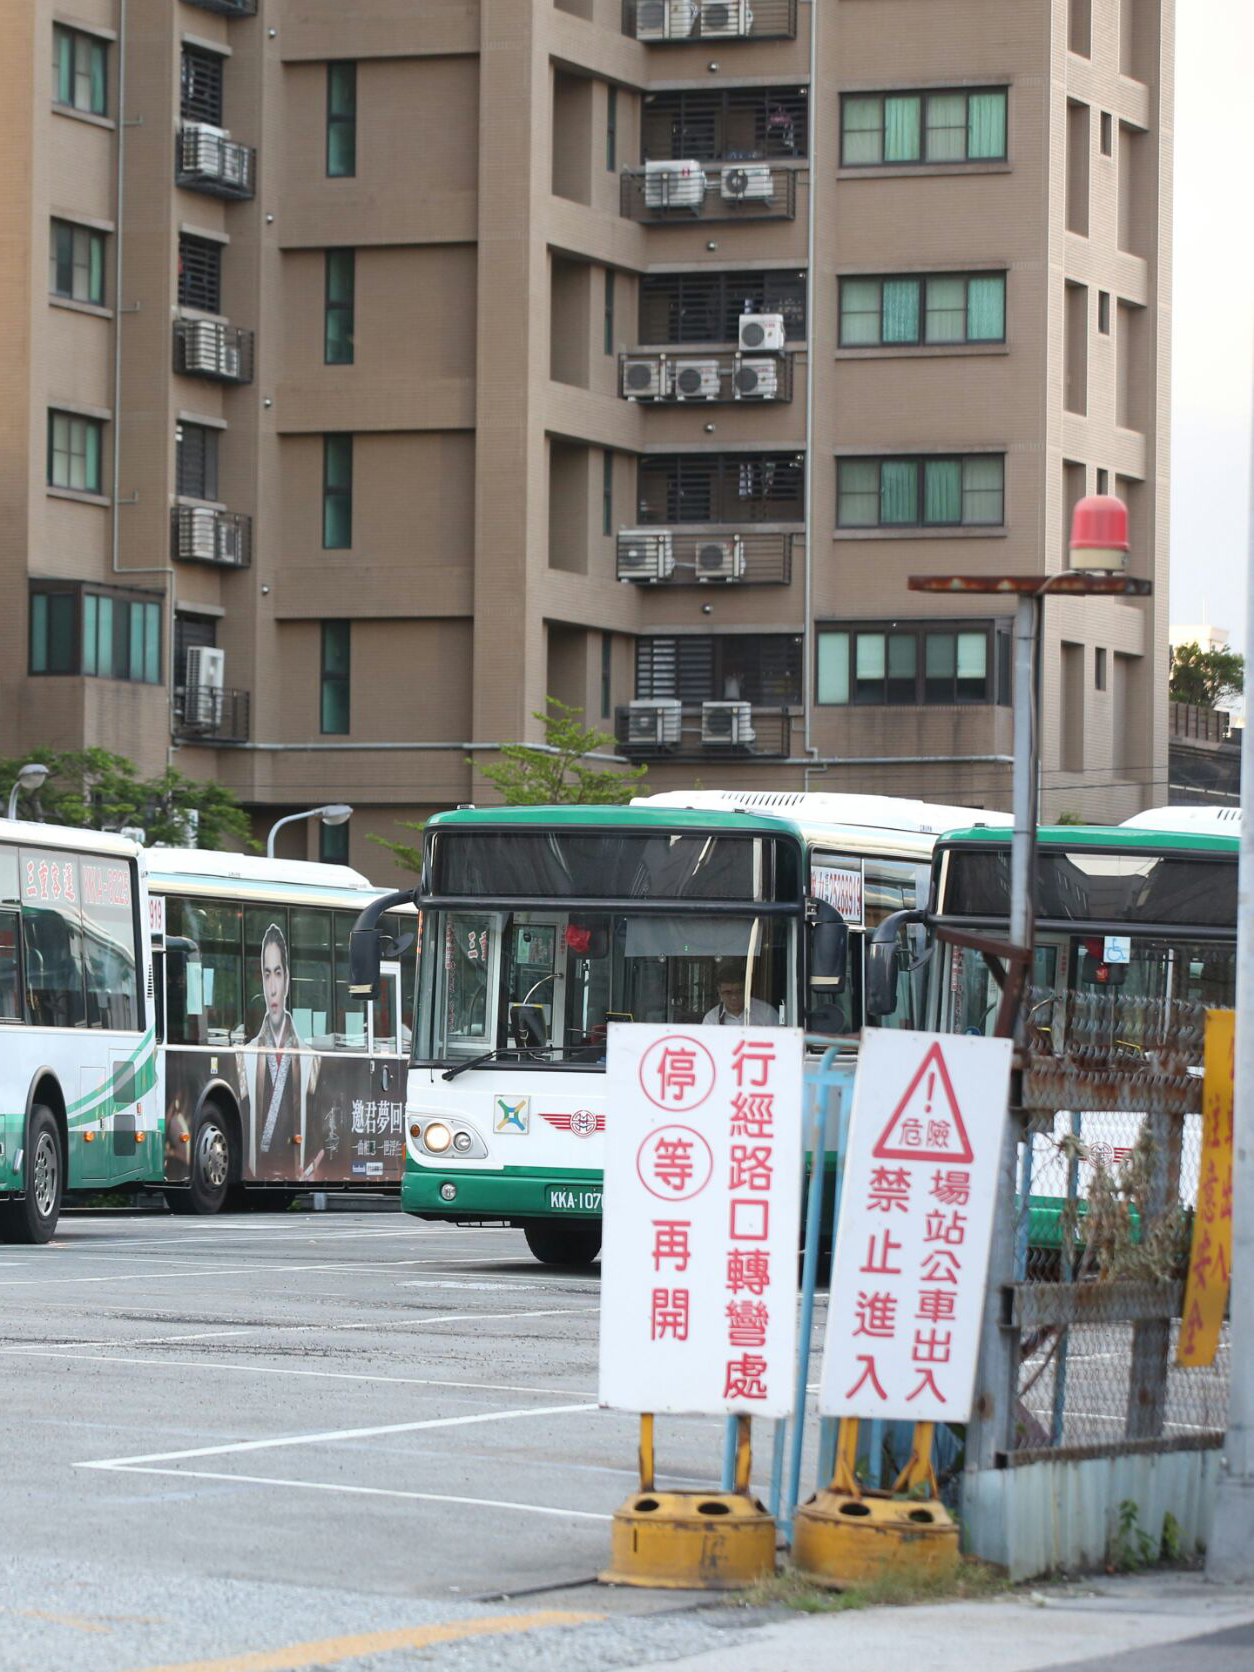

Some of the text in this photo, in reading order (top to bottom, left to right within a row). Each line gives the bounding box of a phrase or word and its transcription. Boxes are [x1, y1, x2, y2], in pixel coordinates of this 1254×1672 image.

[351, 1099, 407, 1135] 邀君夢回
[650, 1045, 698, 1343] 停等再開
[723, 1038, 777, 1402] 行經路口轉彎處
[898, 1117, 950, 1149] 危險
[844, 1165, 912, 1402] 禁止進入
[905, 1169, 970, 1403] 場站公車出入
